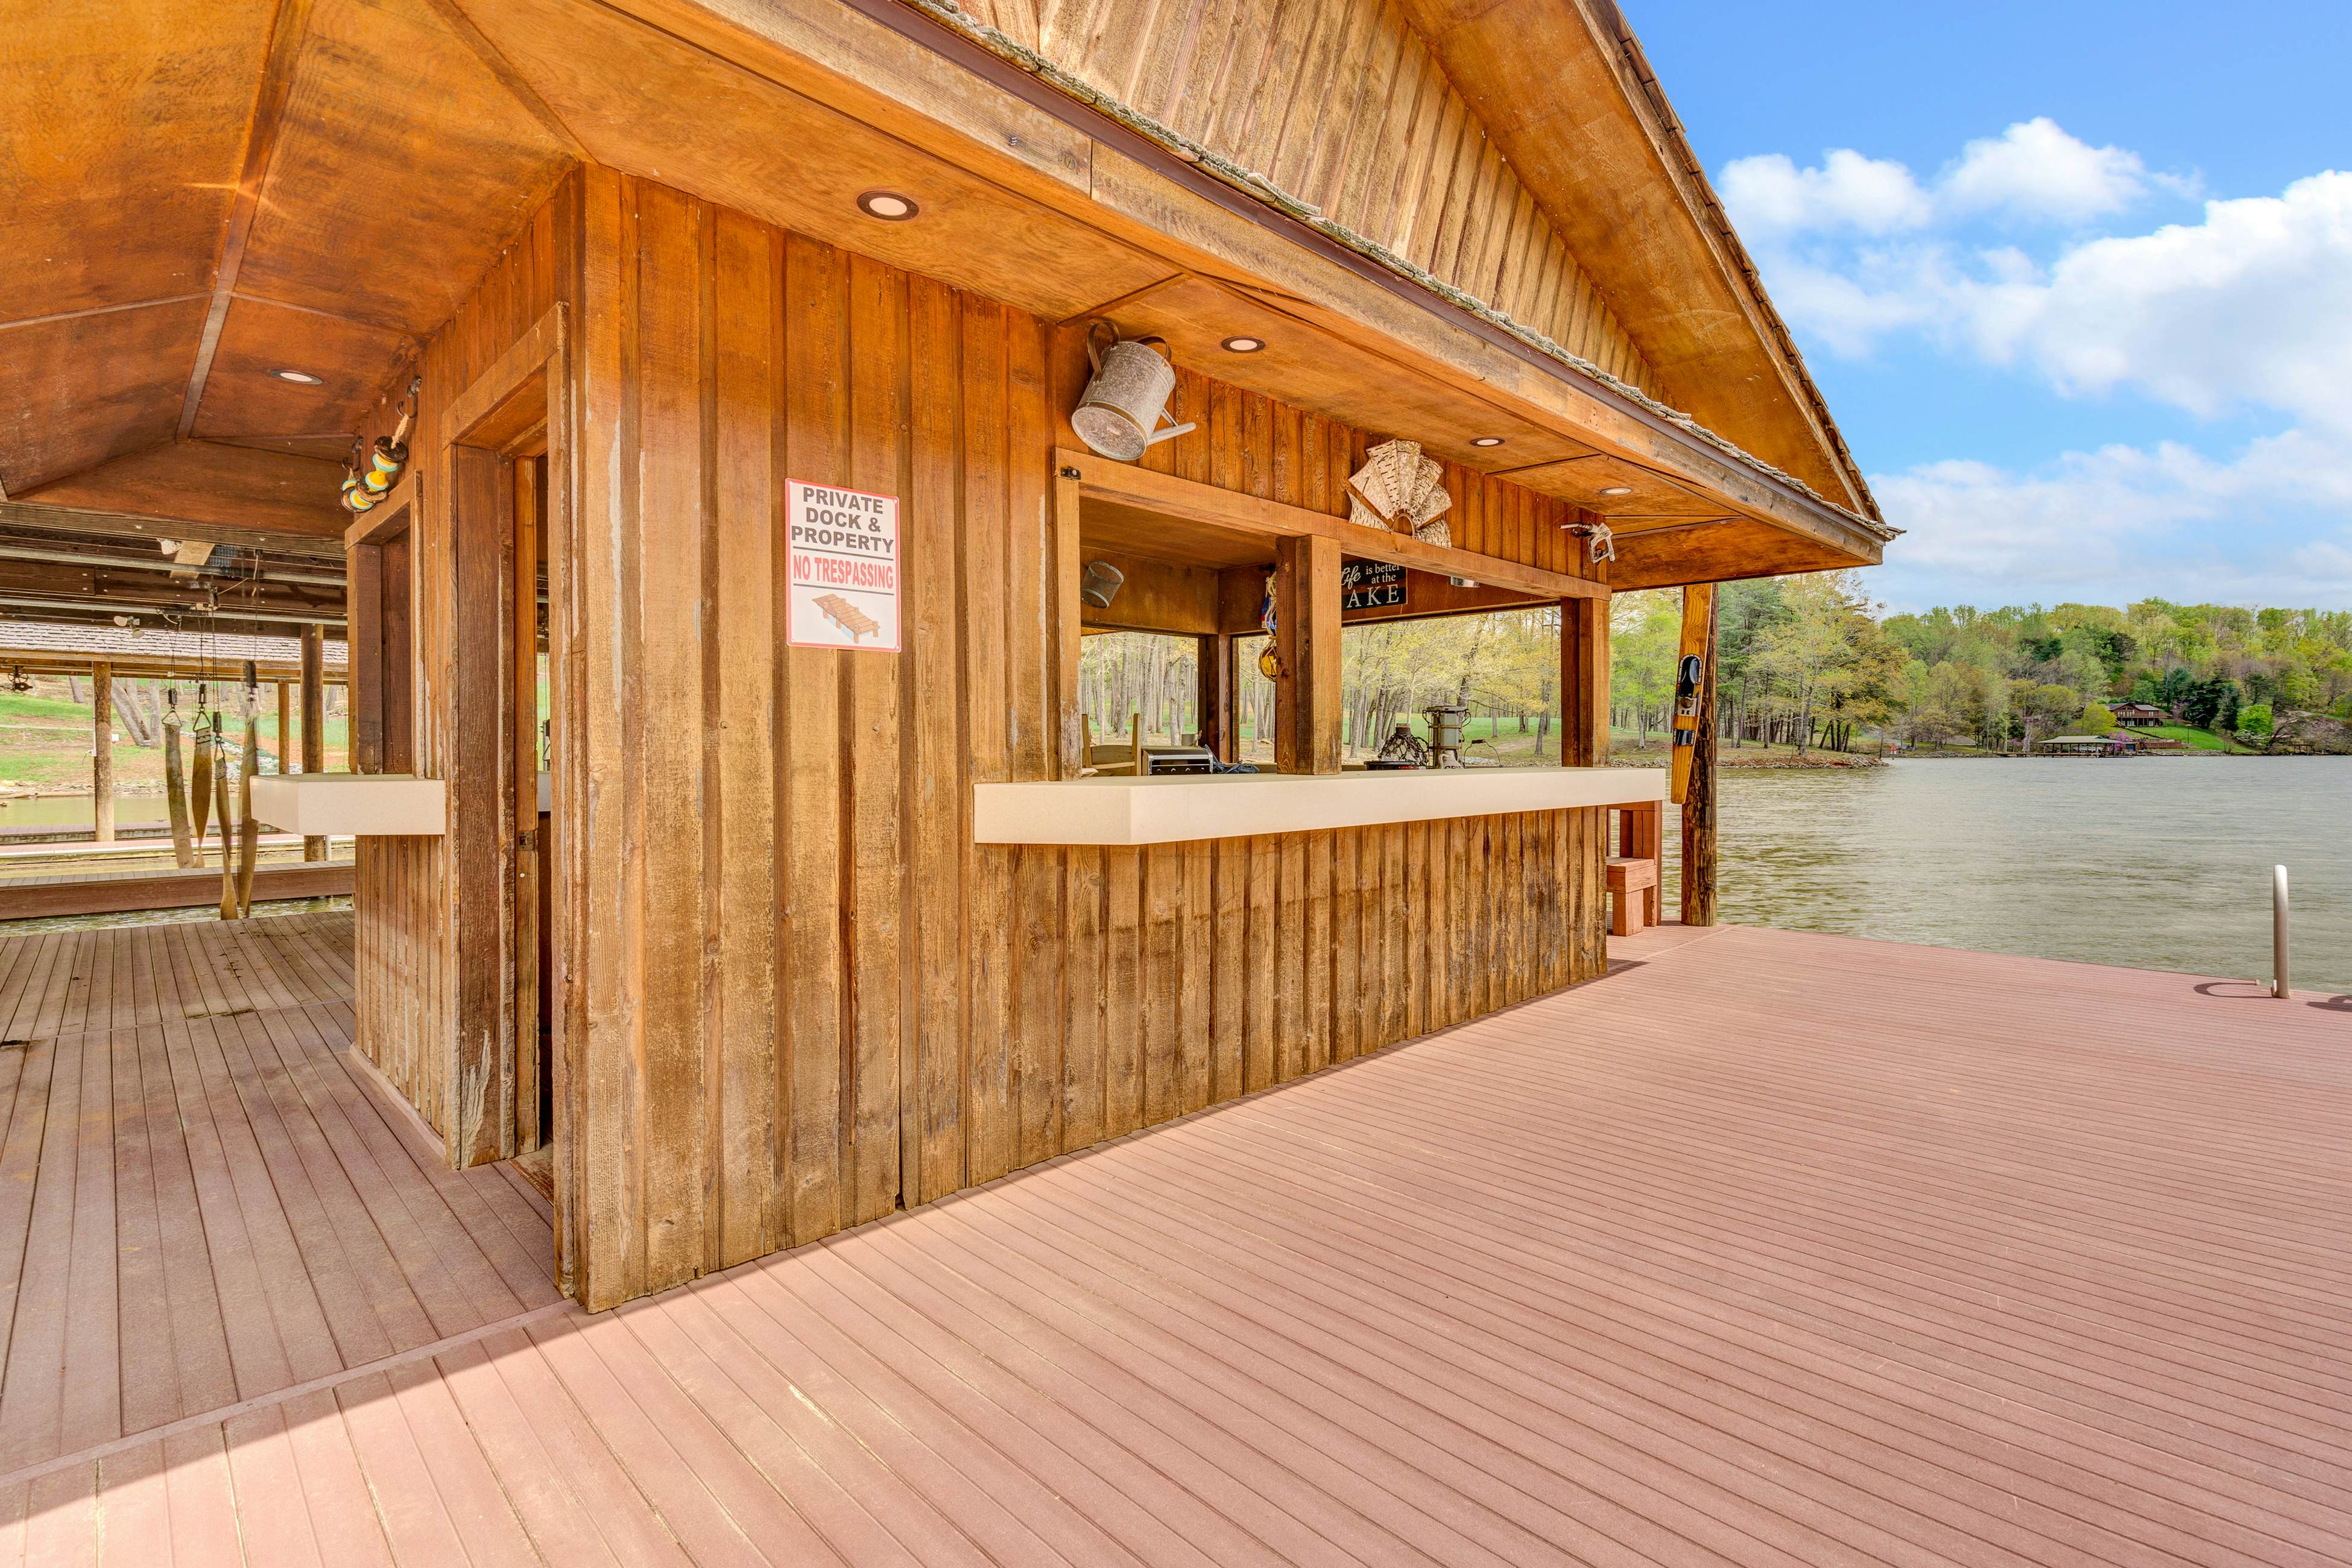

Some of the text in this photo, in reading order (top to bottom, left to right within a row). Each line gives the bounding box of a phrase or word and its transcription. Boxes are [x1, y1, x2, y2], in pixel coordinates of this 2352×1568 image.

[803, 487, 883, 514] PRIVATE
[806, 507, 881, 532] DOCK &
[791, 525, 894, 553] PROPERTY
[794, 555, 893, 589] NO TRESPASSING
[1365, 566, 1373, 575] is
[1371, 572, 1396, 584] at the
[1347, 584, 1399, 608] AKE
